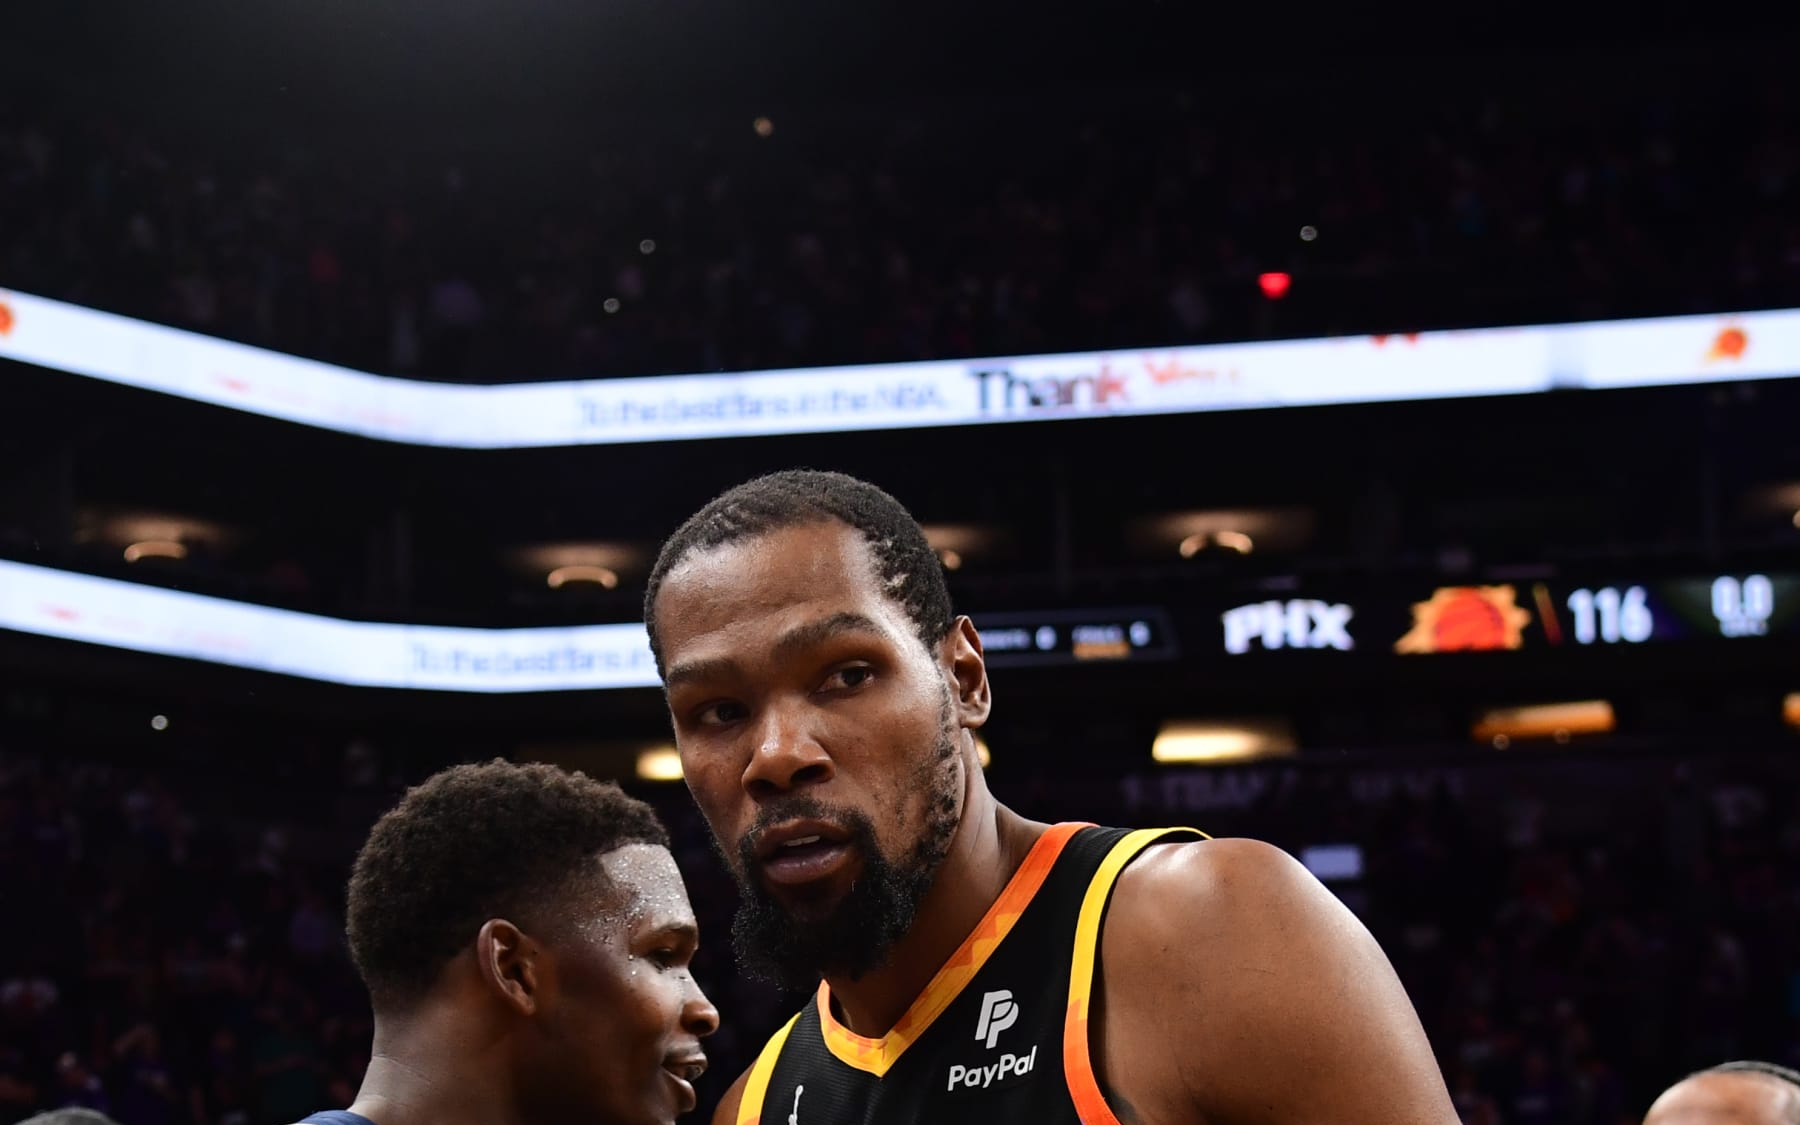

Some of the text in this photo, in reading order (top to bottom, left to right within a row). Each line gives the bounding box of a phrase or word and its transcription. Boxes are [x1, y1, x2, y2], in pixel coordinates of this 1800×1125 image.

[966, 363, 1127, 412] Thank
[1222, 598, 1355, 655] PHX
[1567, 585, 1654, 645] 116
[947, 1045, 1037, 1091] PayPal
